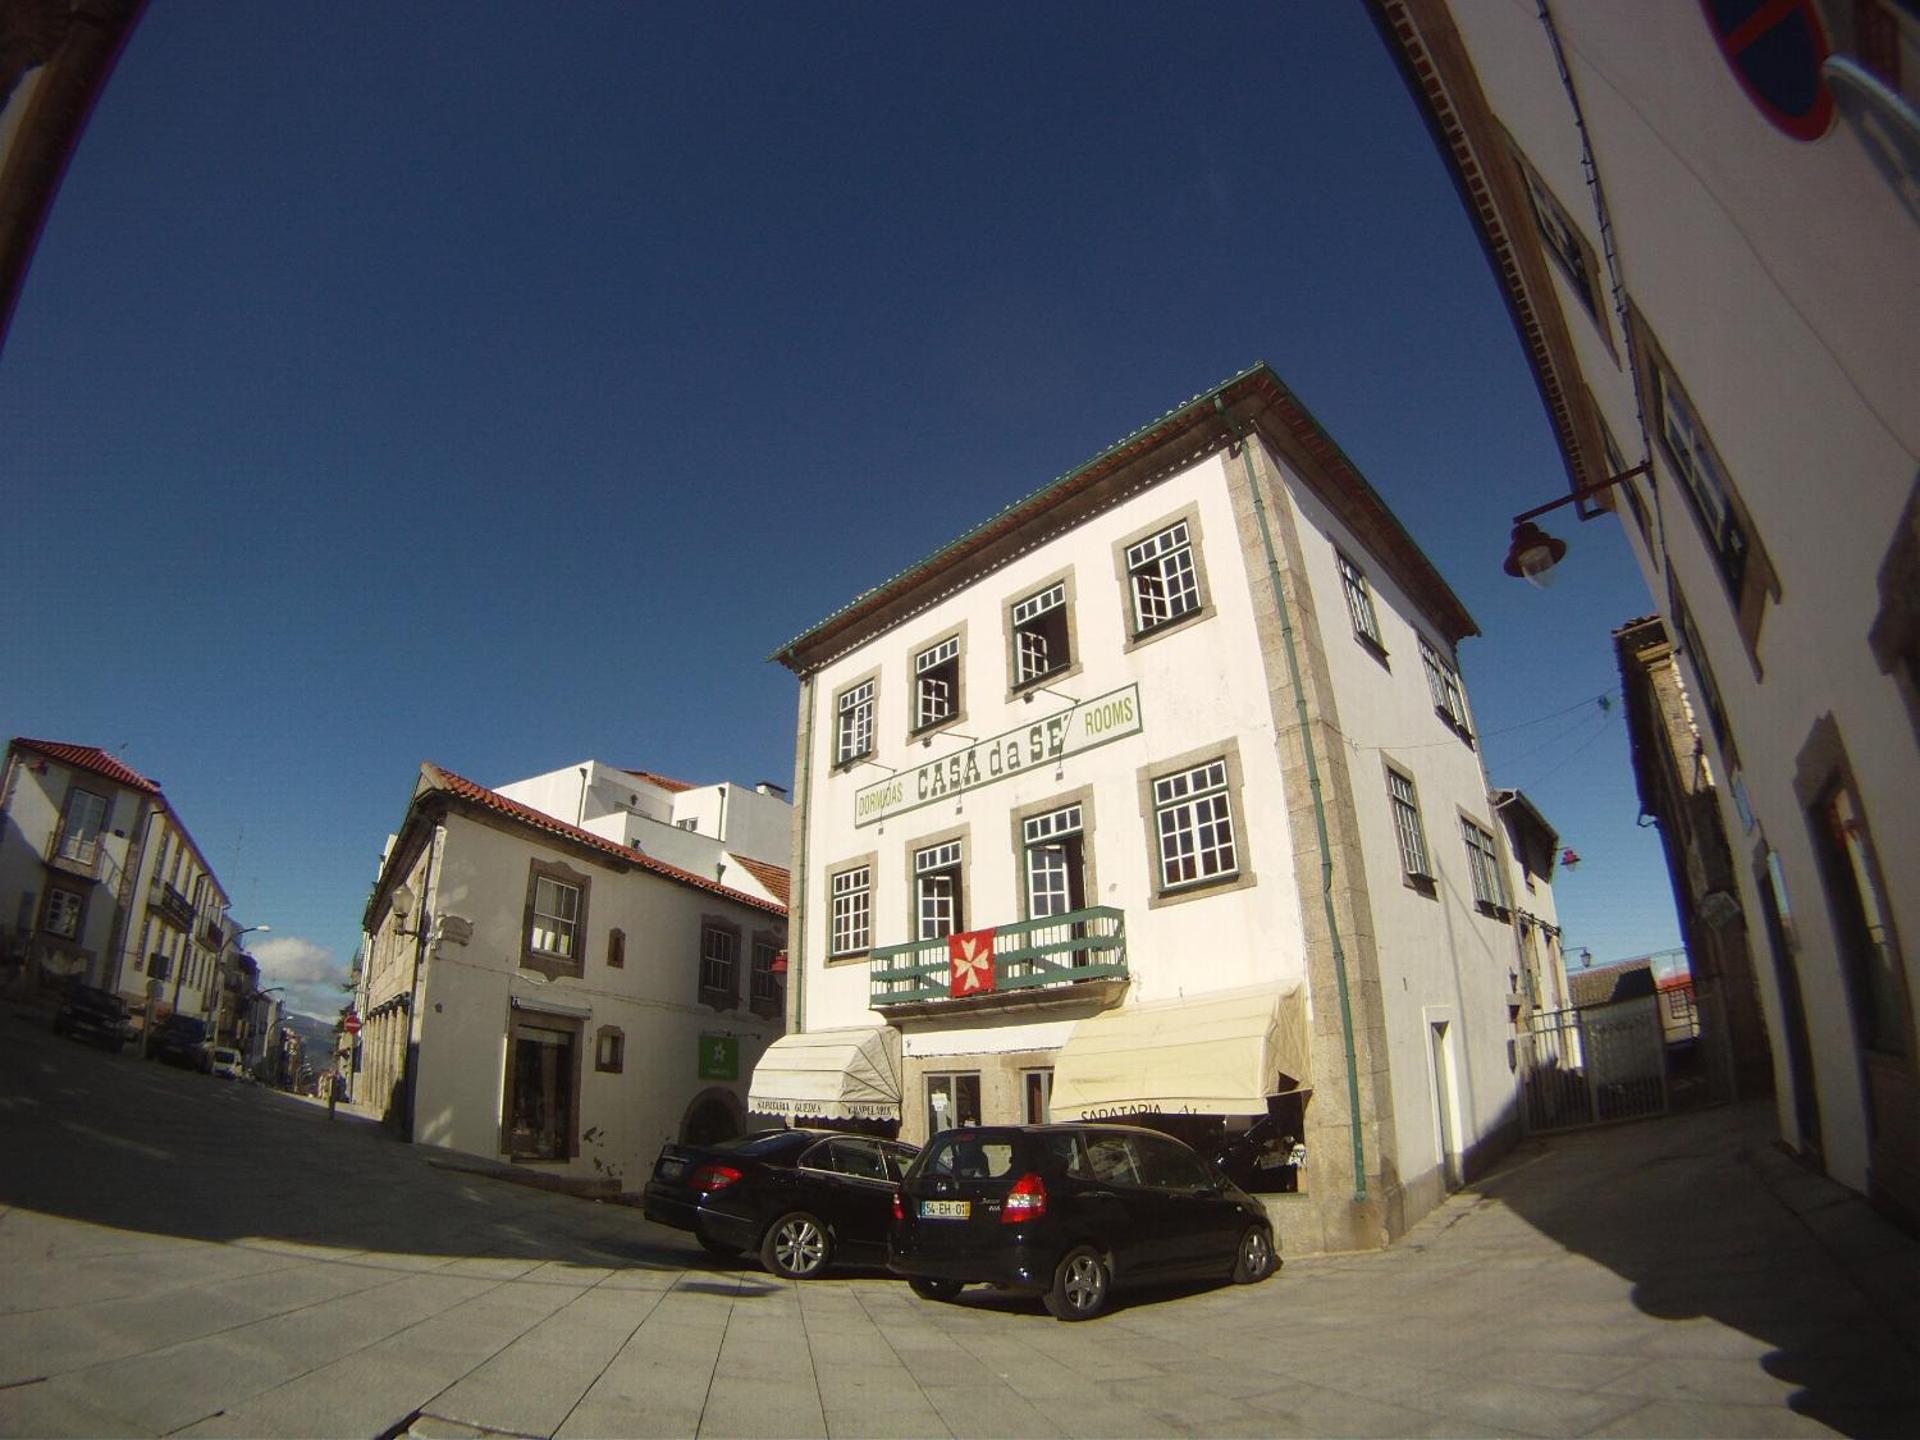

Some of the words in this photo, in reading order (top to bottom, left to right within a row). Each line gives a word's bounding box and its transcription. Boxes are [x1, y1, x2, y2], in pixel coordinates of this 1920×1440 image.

[1084, 696, 1133, 737] ROOMS
[917, 749, 981, 801] CASA
[989, 740, 1021, 777] da
